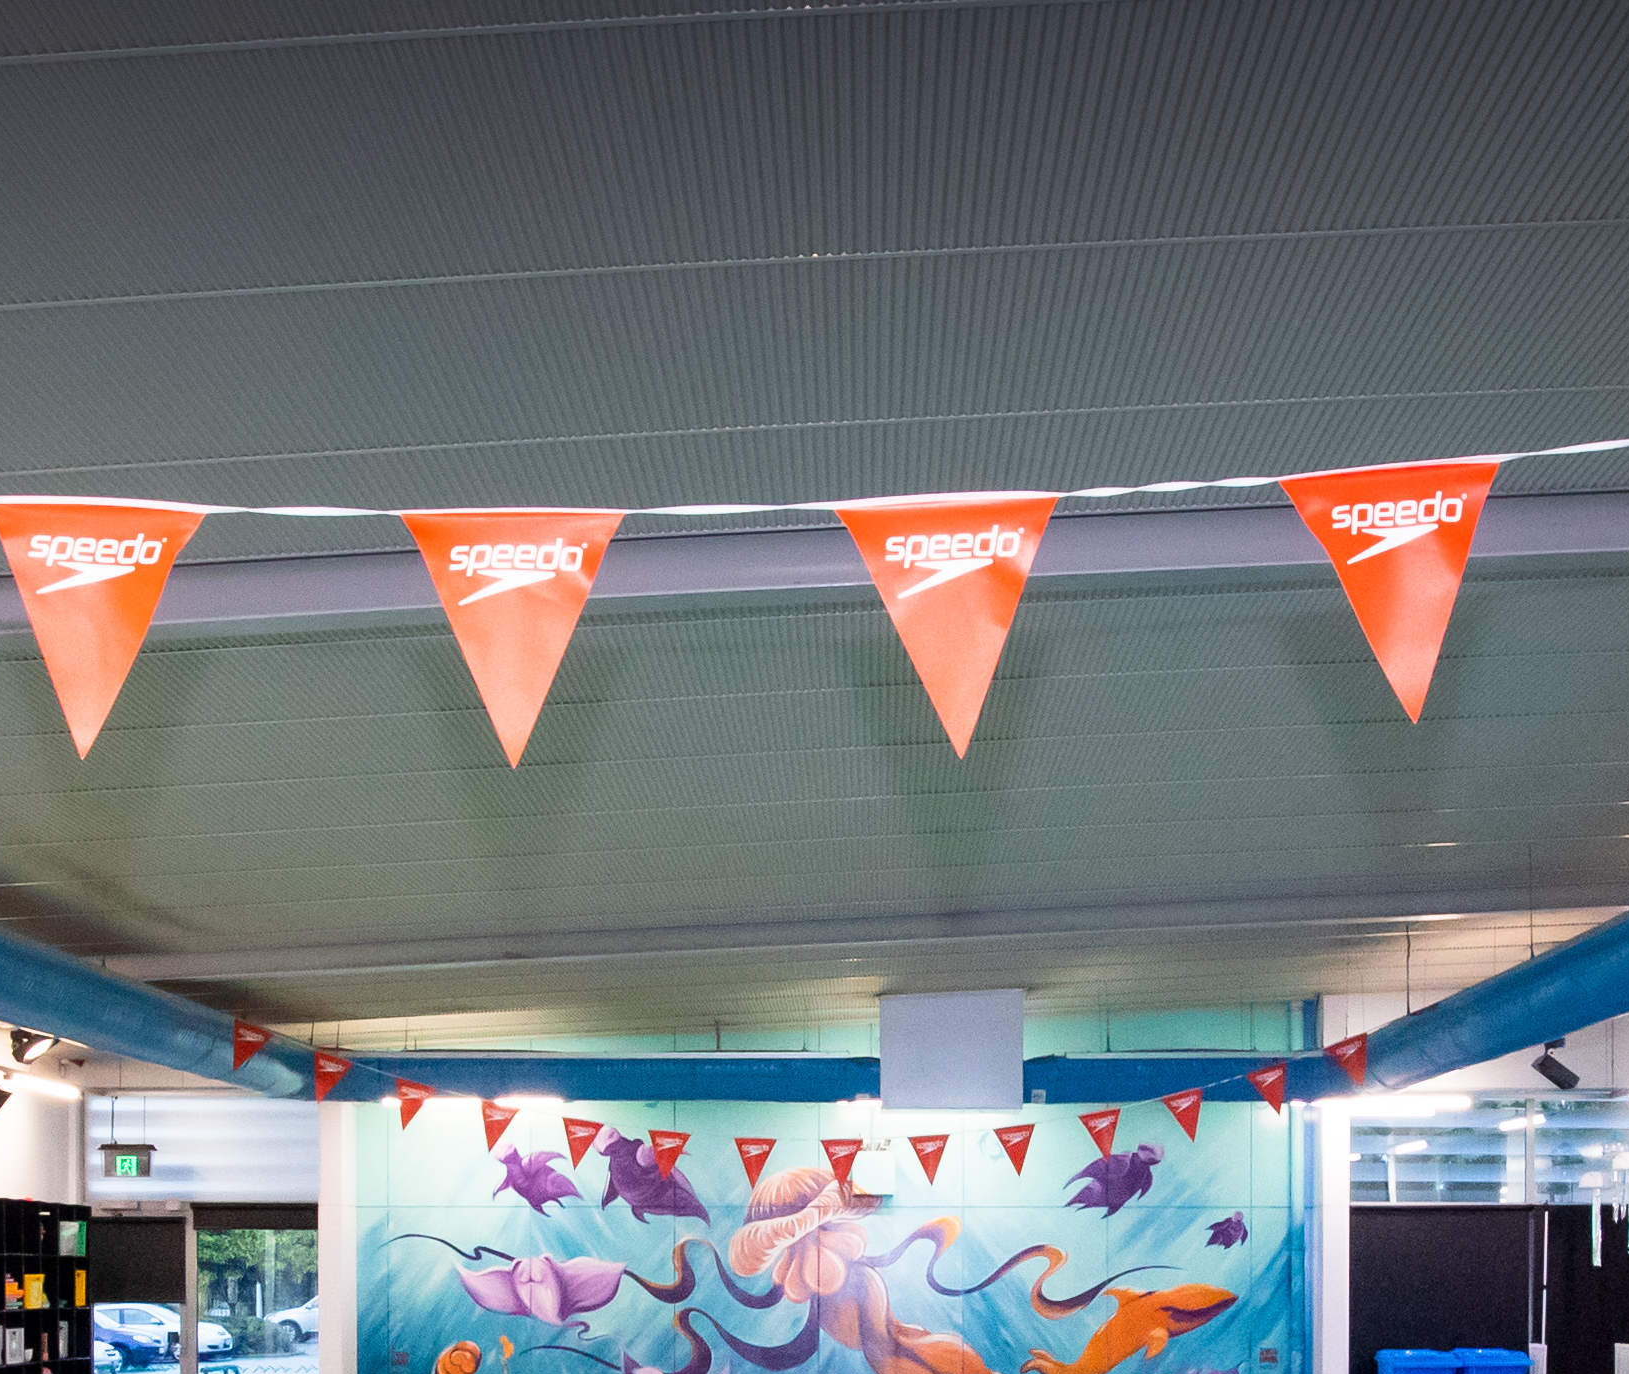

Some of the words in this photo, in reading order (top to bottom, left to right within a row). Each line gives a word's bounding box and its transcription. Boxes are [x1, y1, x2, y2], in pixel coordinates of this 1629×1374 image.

[1331, 491, 1463, 535] speedo
[28, 533, 161, 566] speedo
[449, 538, 584, 576] speedo
[885, 525, 1020, 568] speedo
